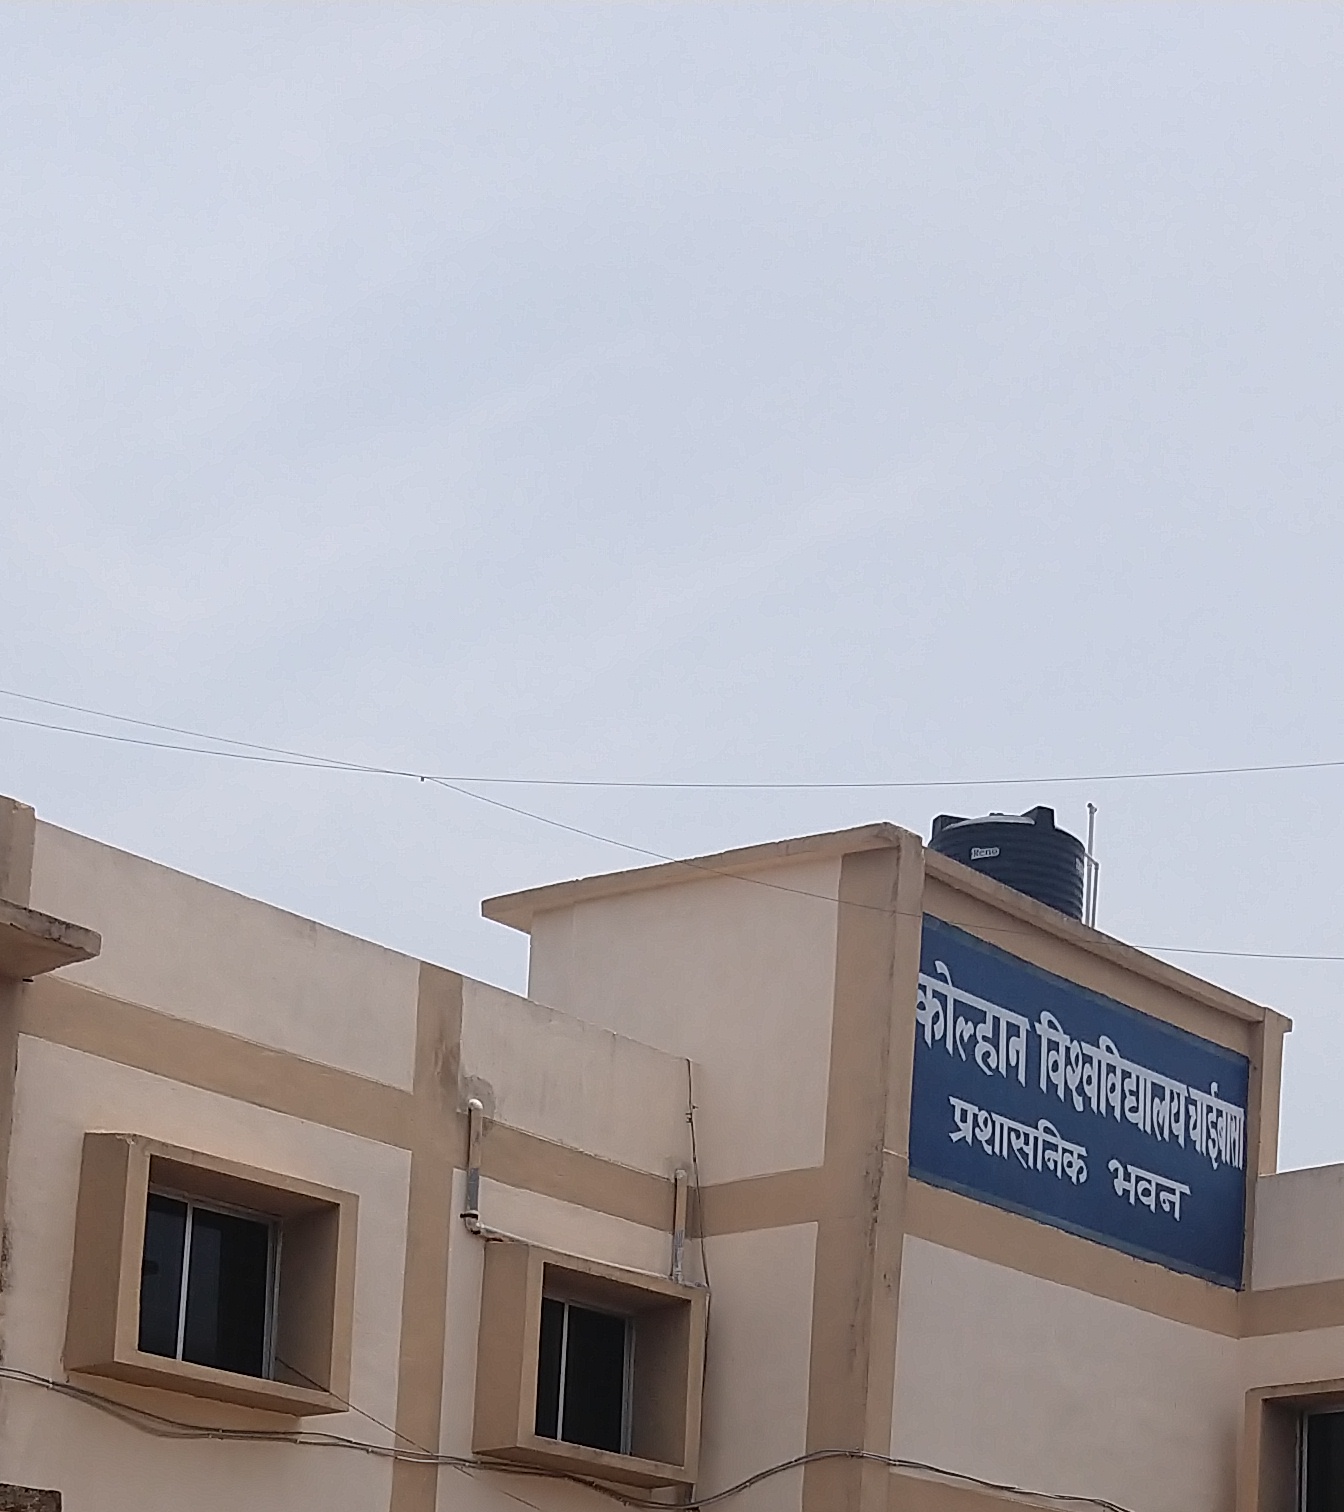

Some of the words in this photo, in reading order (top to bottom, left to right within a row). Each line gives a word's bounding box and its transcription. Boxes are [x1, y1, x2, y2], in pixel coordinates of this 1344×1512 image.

[916, 960, 1031, 1088] कोल्हान
[1034, 1010, 1189, 1149] विश्वविद्यालय
[1187, 1081, 1245, 1171] चाईबासा
[948, 1095, 1088, 1185] प्रशासनिक
[1108, 1158, 1192, 1222] भवन
